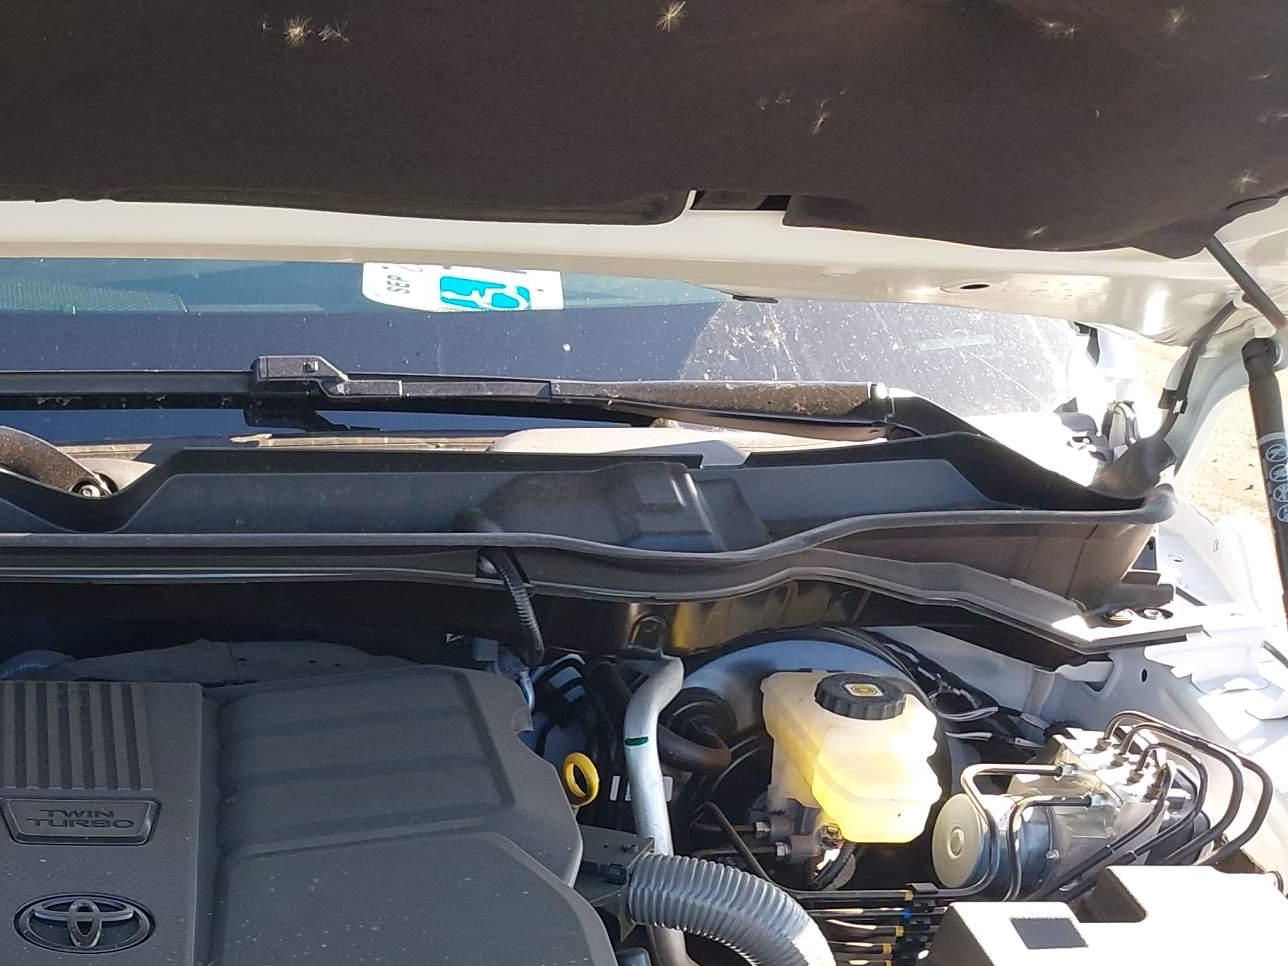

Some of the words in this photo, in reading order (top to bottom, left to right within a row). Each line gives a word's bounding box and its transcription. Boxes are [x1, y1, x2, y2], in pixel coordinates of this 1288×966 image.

[386, 274, 411, 295] SEP
[39, 809, 114, 819] TWIN
[26, 818, 135, 829] TURBO
